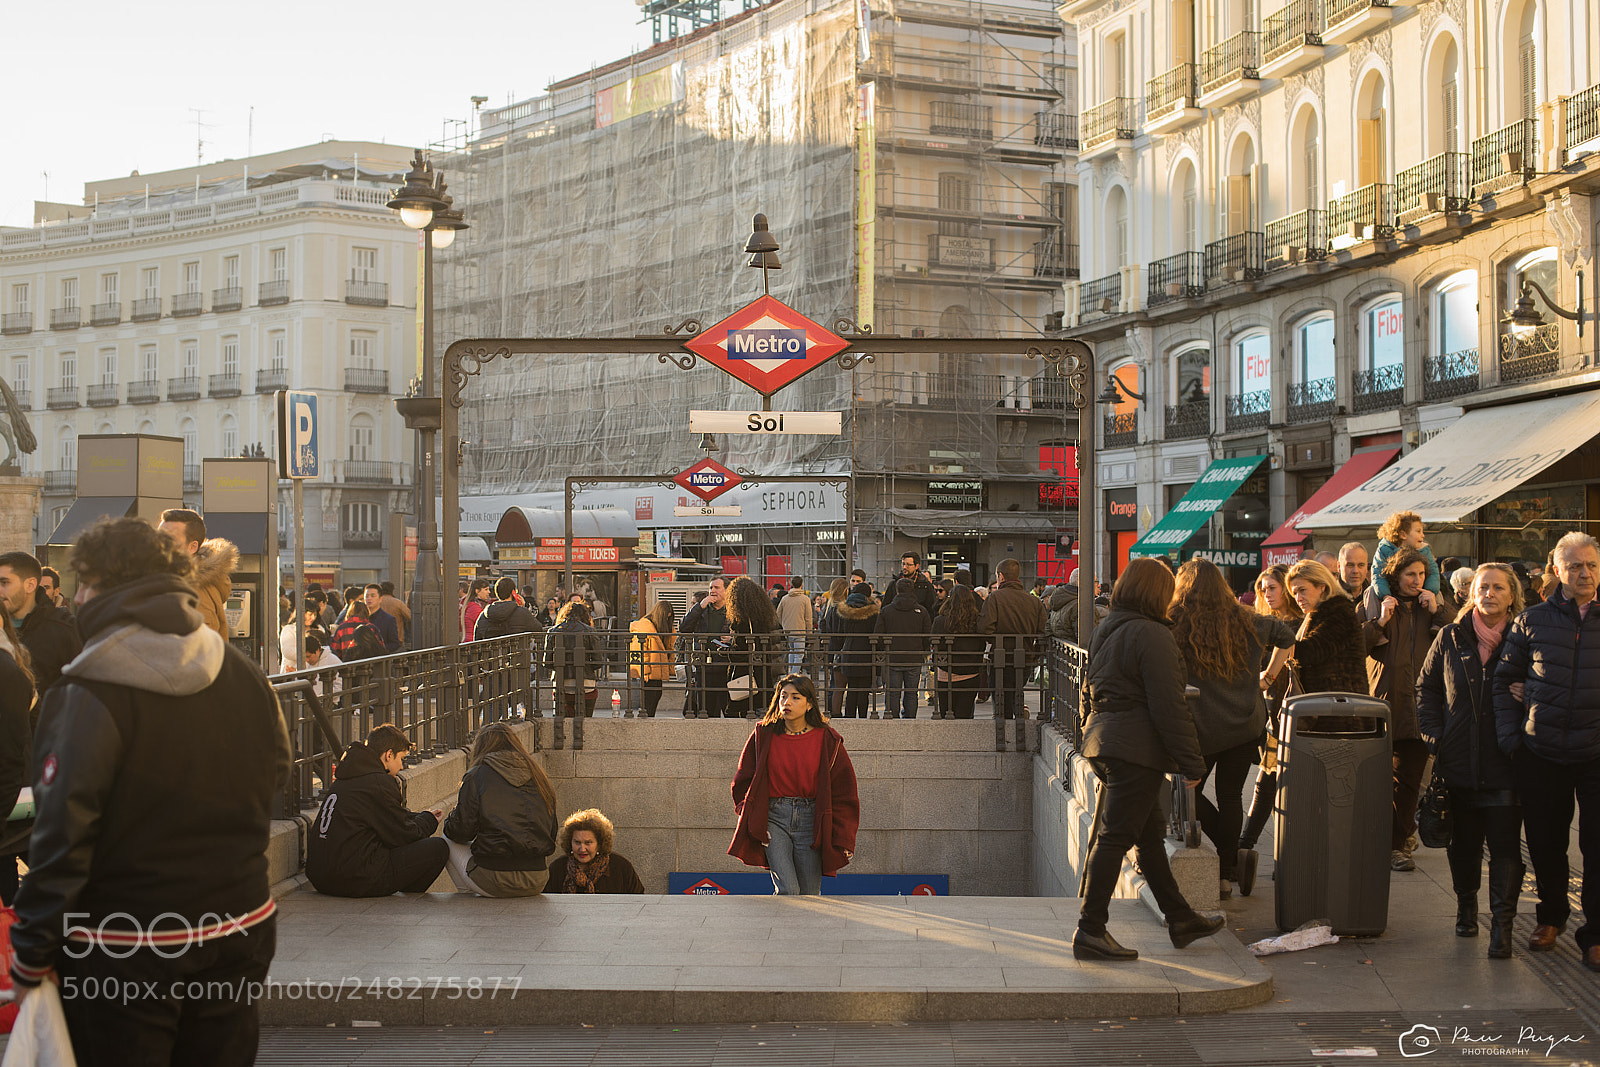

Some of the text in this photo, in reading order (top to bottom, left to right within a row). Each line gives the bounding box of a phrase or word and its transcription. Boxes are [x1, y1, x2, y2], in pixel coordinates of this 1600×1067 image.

[735, 334, 800, 353] Metro
[1246, 356, 1270, 380] Fibr
[746, 413, 785, 432] Sol
[295, 402, 313, 467] P
[1201, 465, 1253, 484] CHANGE
[1360, 466, 1447, 492] CASA
[1438, 448, 1566, 491] DIEGO
[692, 474, 723, 484] Metro
[762, 489, 827, 512] SEPHORA
[1173, 498, 1223, 513] TRANSFER
[465, 512, 483, 522] THOR
[700, 507, 715, 515] Sol
[1110, 501, 1137, 518] Orange
[1142, 529, 1193, 545] CAMBIO
[588, 547, 616, 560] TICKETS
[1192, 550, 1258, 566] CHANGE
[1273, 553, 1299, 567] CHANGE
[696, 888, 717, 896] Metro
